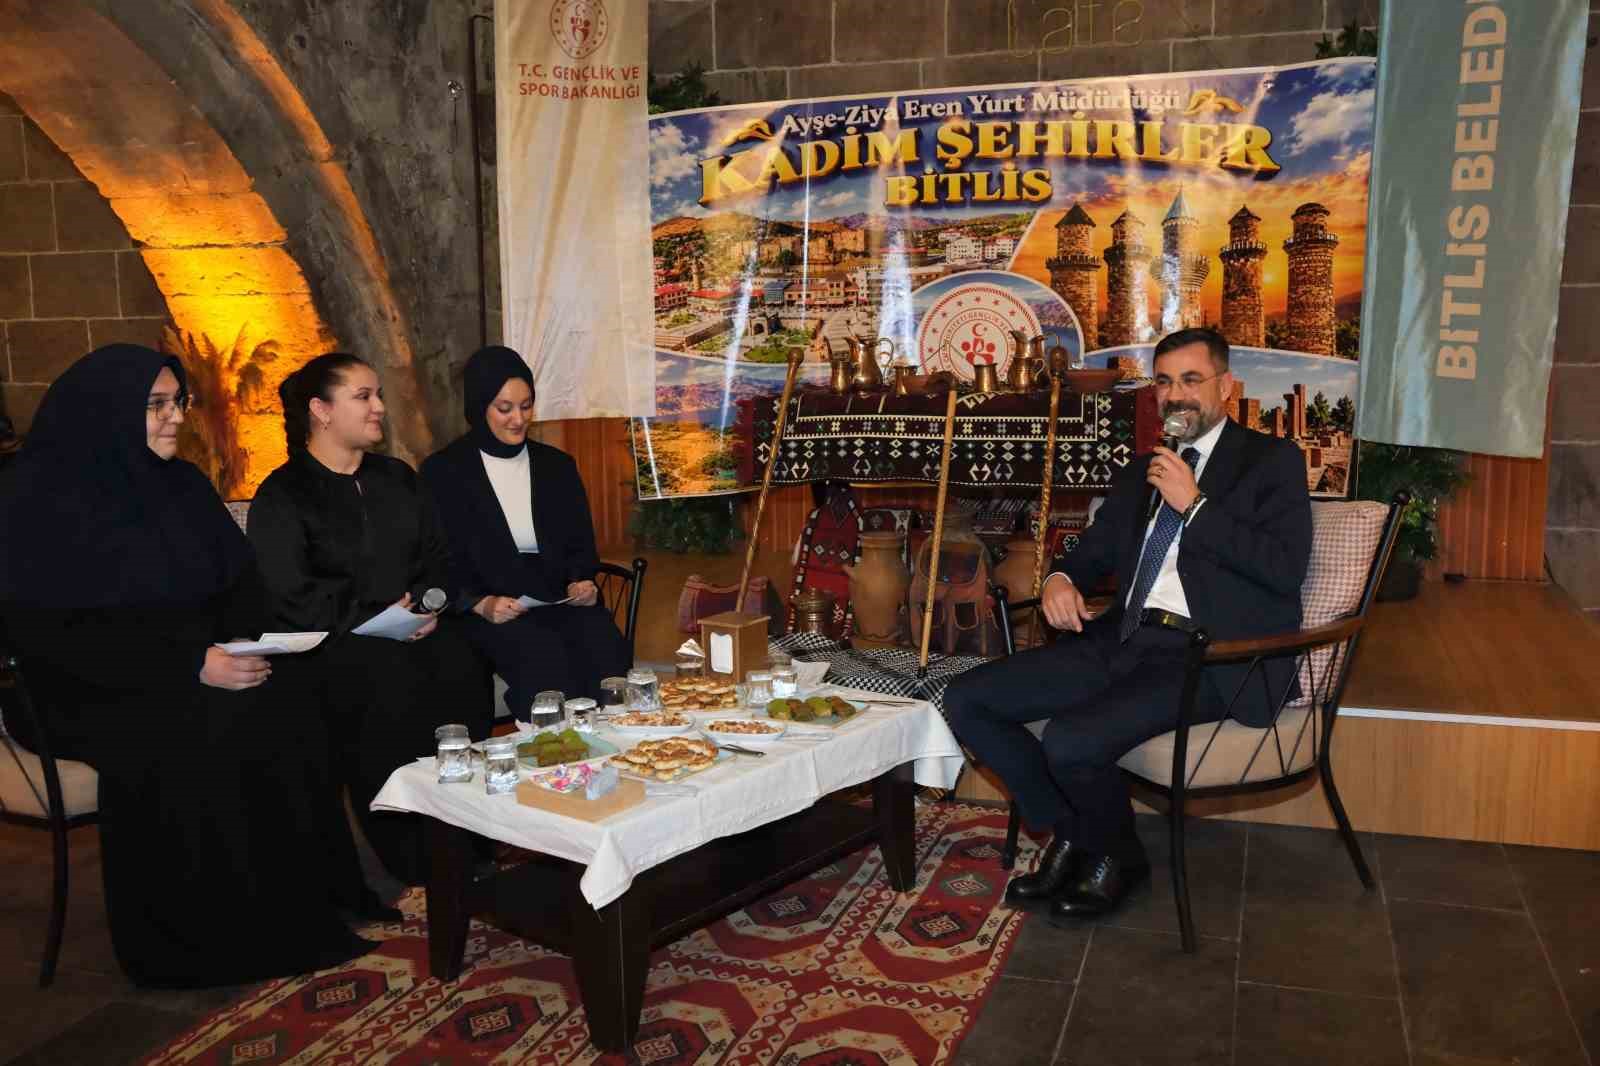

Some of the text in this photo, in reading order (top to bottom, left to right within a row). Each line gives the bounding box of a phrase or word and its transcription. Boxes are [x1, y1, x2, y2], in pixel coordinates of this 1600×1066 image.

[517, 64, 640, 82] T.C. GENÇLİK VE
[1451, 0, 1507, 191] BELED
[783, 86, 1181, 137] Ayşe-Ziya Eren Yurt Müdürlüğü
[698, 111, 1282, 205] KADİM ŞEHİRLER
[884, 161, 1054, 207] BİTLİS
